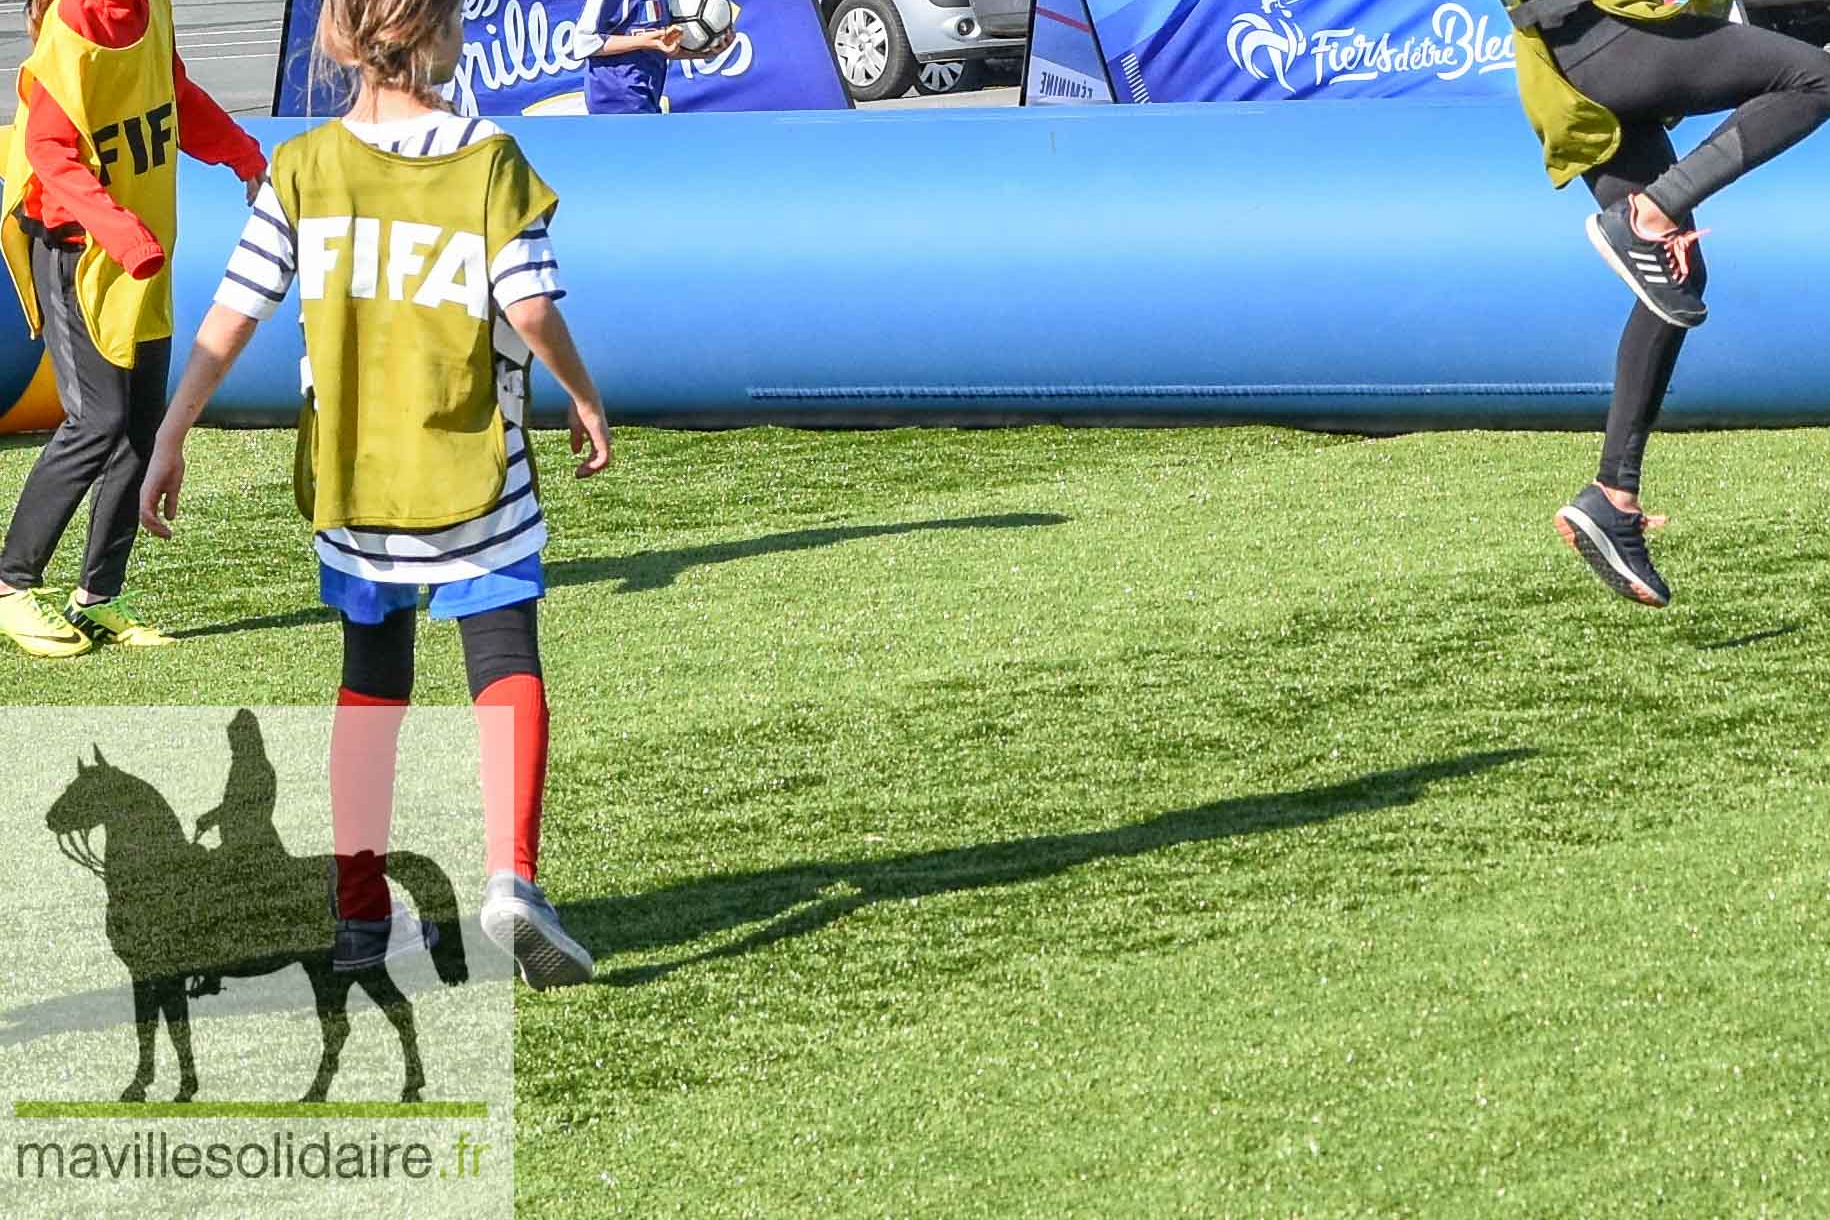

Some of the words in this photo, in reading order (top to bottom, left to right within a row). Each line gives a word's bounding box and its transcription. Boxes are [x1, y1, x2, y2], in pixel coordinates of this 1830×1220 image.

[1311, 27, 1397, 86] Fiers
[91, 102, 178, 188] FIF
[298, 215, 489, 321] FIFA
